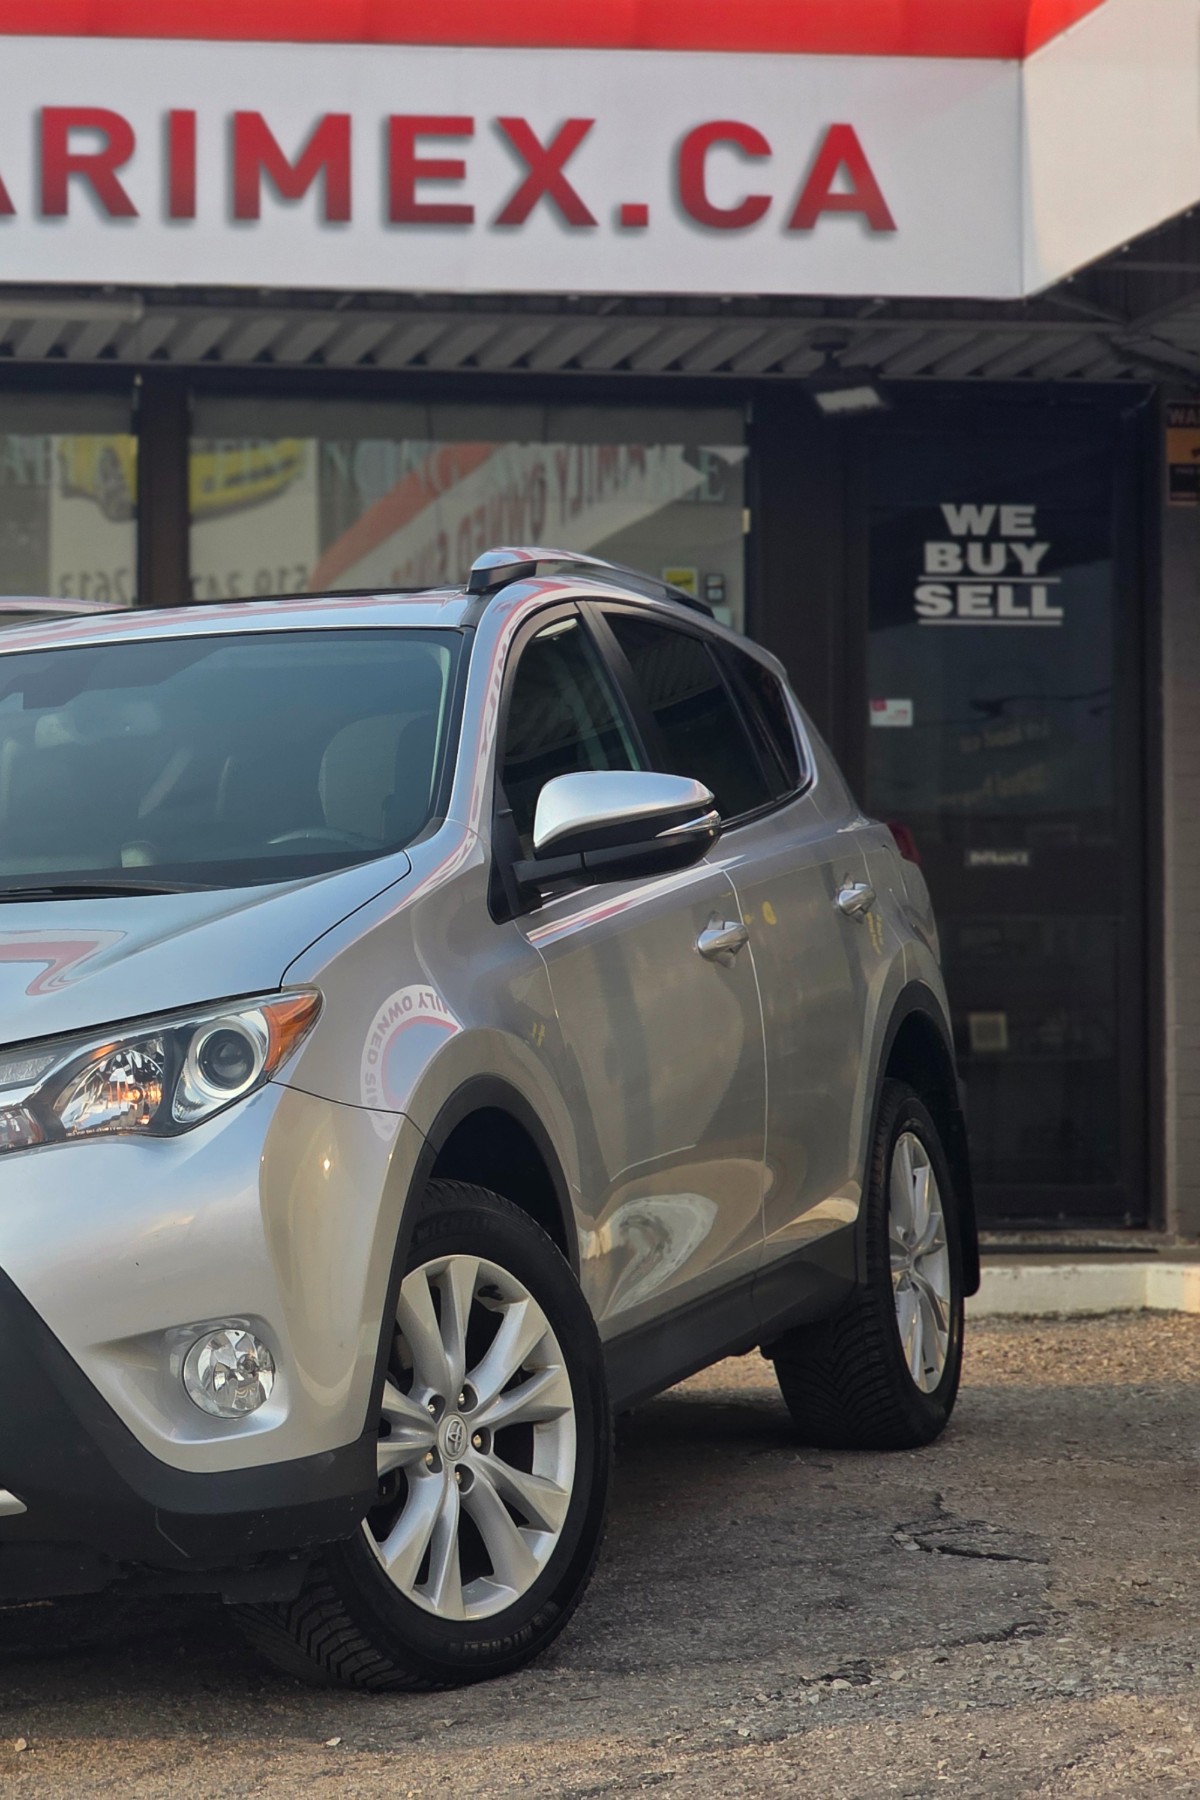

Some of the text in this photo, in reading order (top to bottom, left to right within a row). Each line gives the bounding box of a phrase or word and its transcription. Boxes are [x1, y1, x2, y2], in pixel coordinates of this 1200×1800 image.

[940, 503, 1036, 536] WE
[924, 541, 1050, 575] BUY
[914, 584, 1063, 617] SELL
